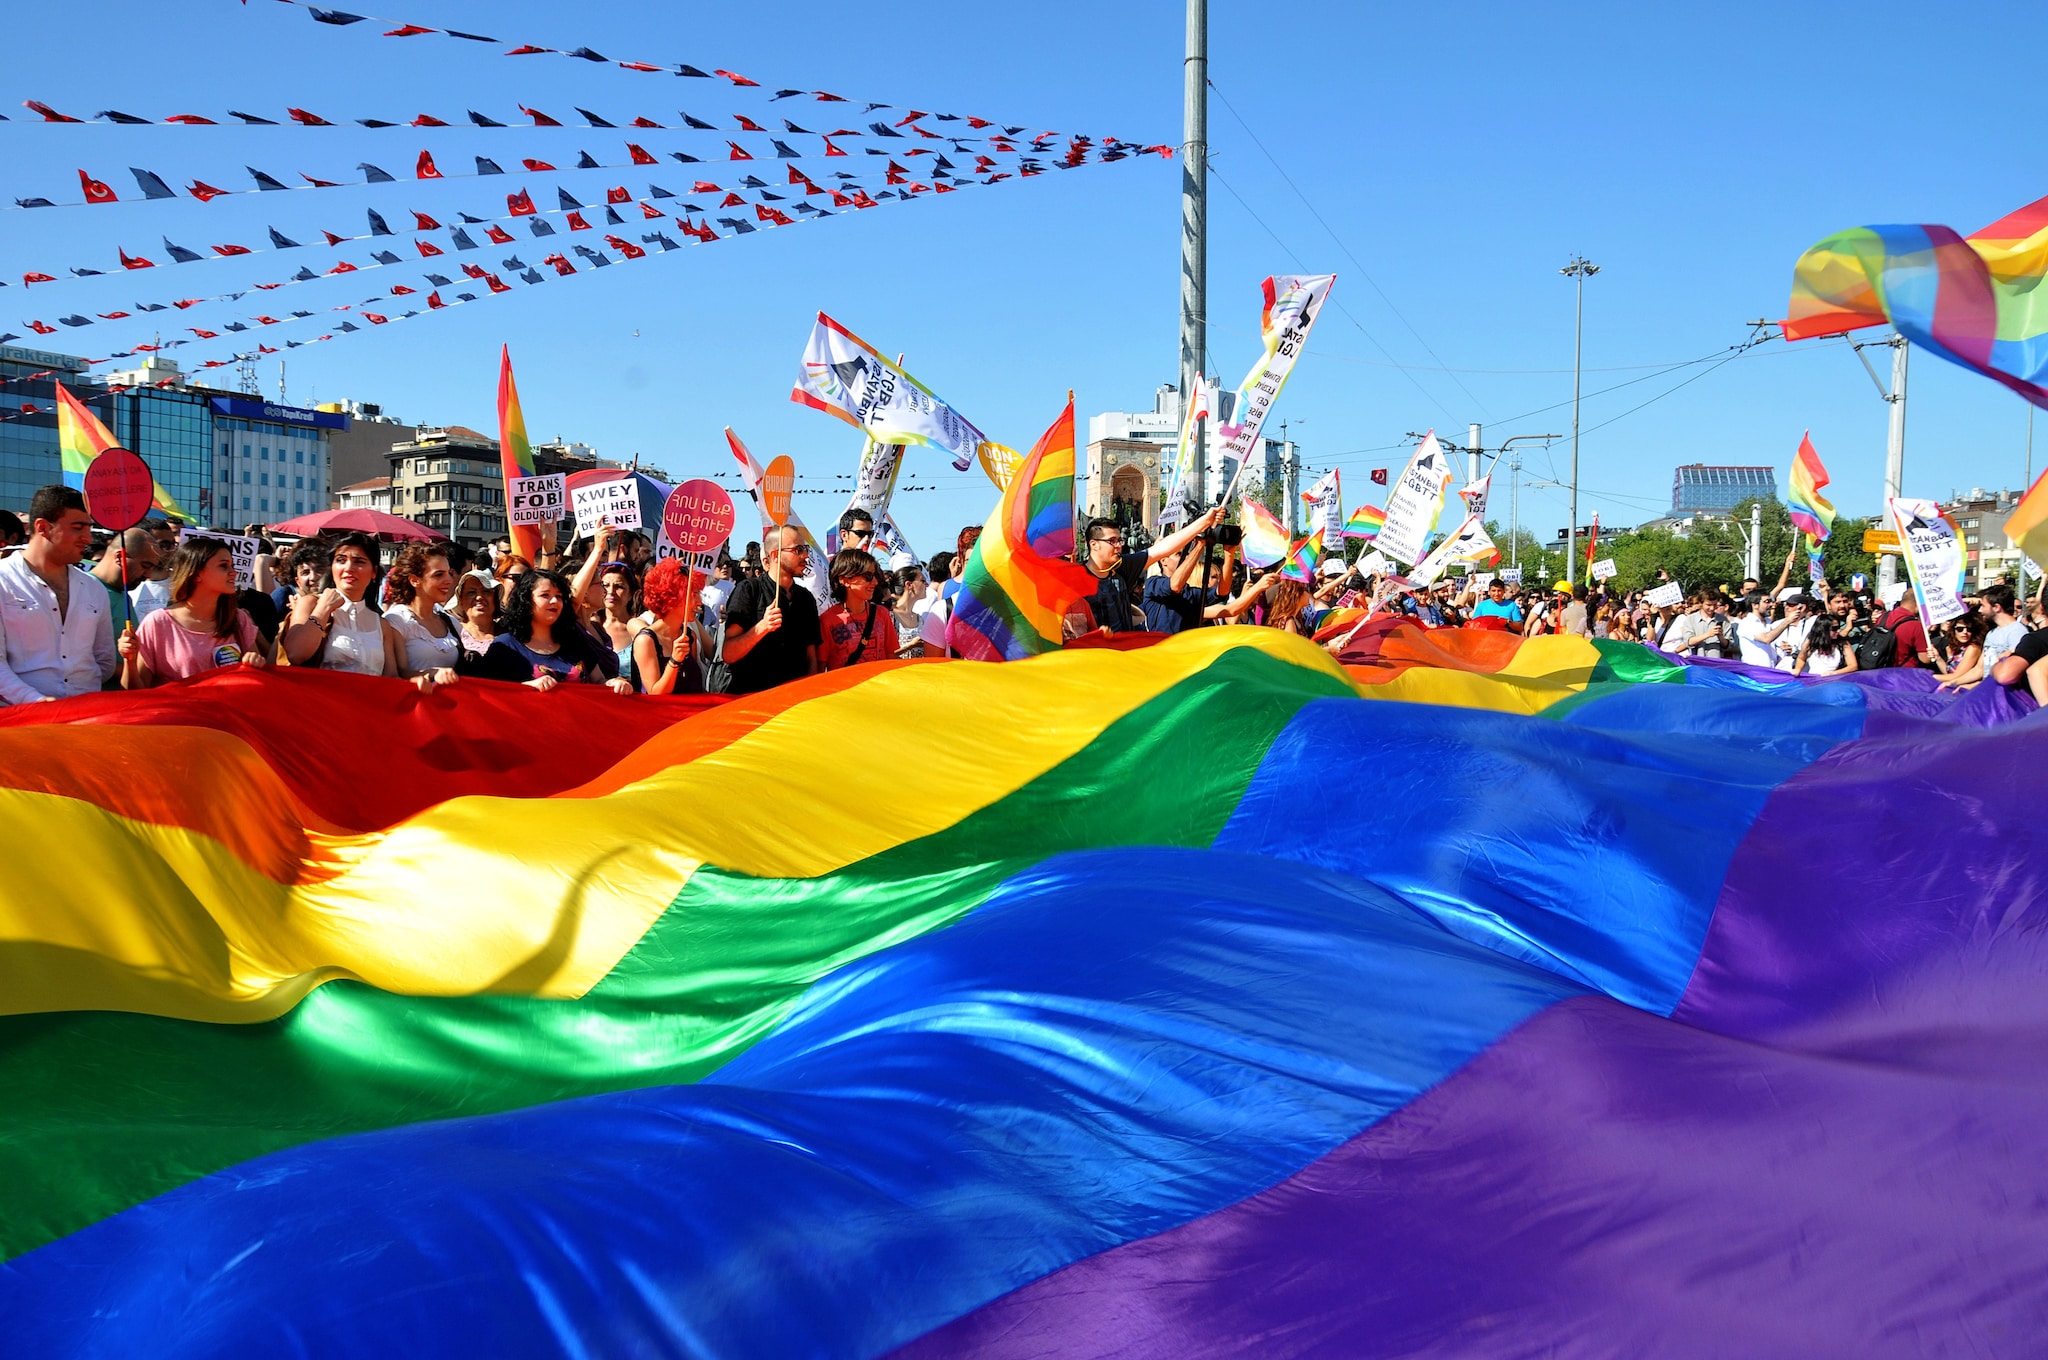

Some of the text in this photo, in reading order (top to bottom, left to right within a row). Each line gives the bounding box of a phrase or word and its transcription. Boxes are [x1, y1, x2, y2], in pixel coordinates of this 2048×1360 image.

[517, 478, 560, 493] TRANS
[577, 483, 632, 504] XWEY
[1403, 475, 1438, 501] LGBTT
[513, 487, 563, 508] FOBİ
[672, 493, 731, 516] ՀՈՍ ԵՆՔ
[102, 505, 119, 515] YER
[578, 507, 593, 518] EM
[610, 500, 637, 511] HER
[615, 514, 637, 525] NE!
